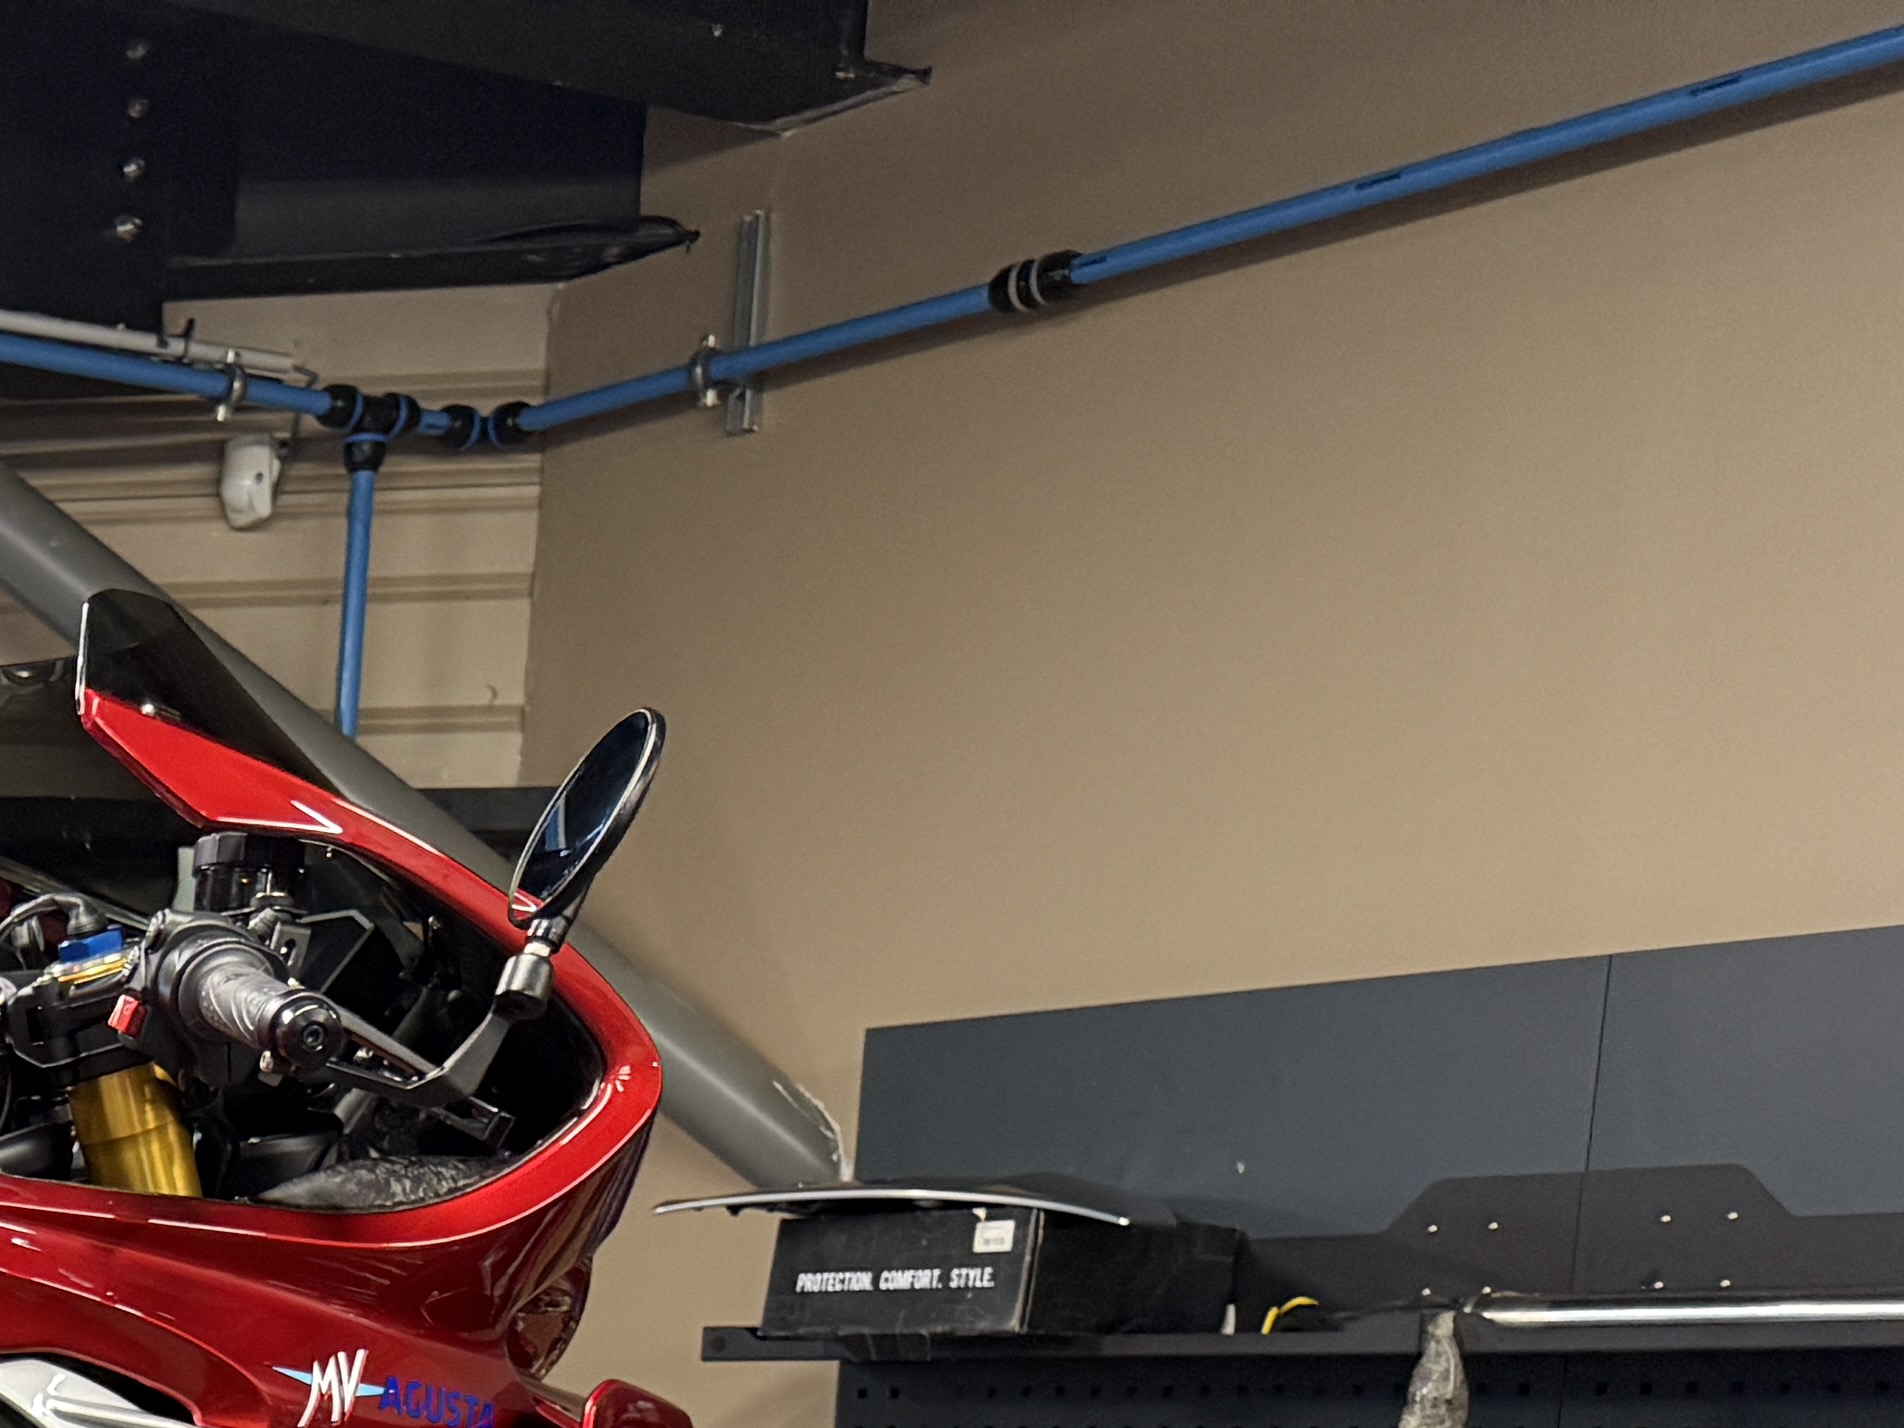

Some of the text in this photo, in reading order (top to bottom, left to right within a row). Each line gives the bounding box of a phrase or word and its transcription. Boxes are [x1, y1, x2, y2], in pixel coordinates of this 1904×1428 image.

[796, 1266, 995, 1293] PROTECTION. COMFORT. STYLE.
